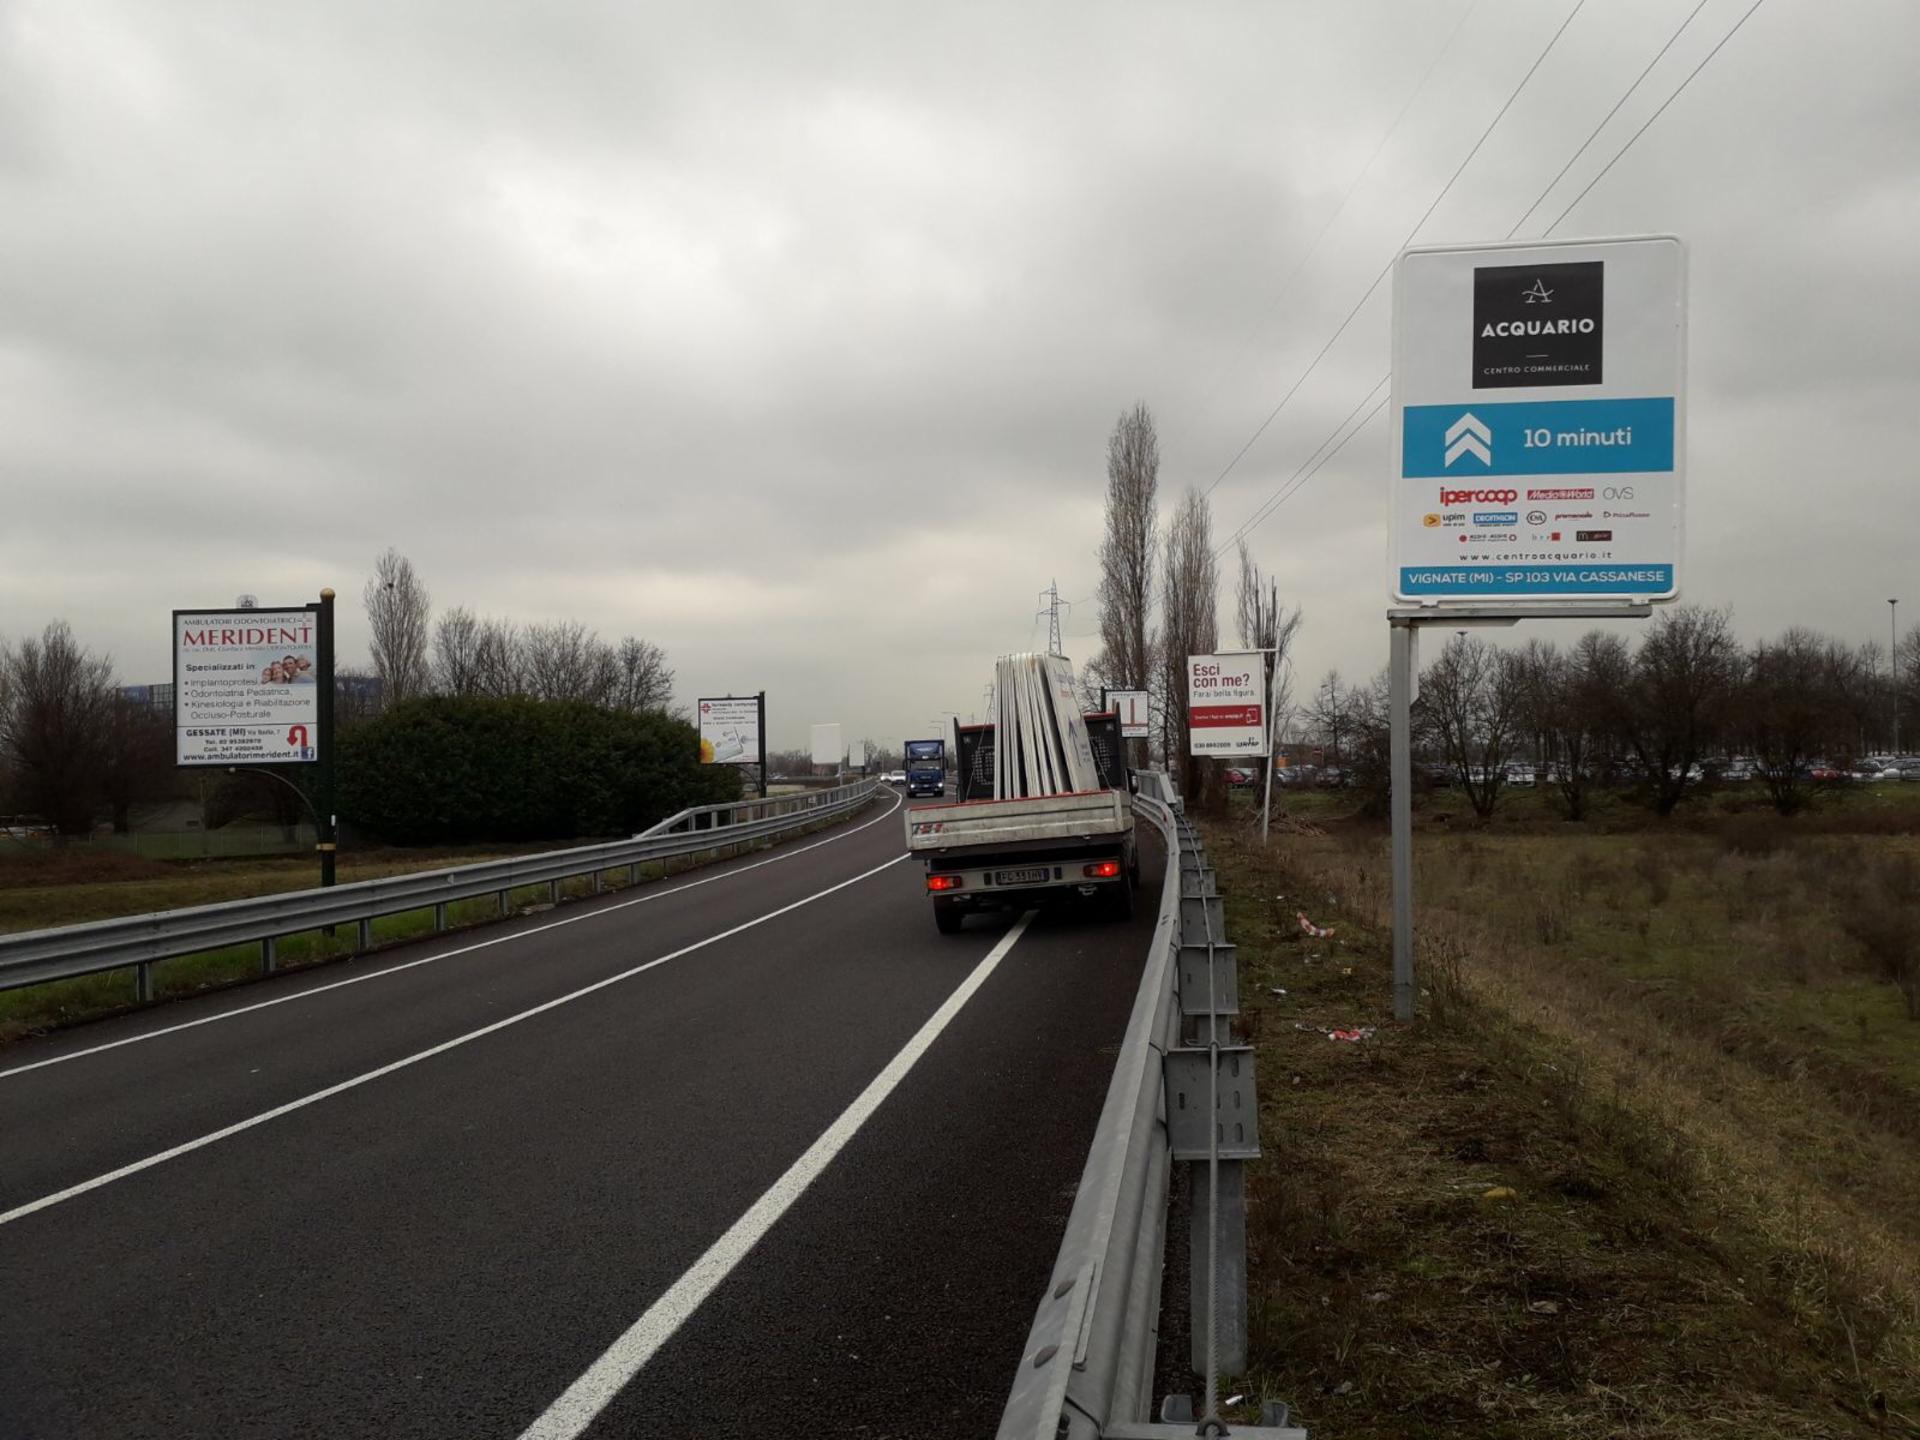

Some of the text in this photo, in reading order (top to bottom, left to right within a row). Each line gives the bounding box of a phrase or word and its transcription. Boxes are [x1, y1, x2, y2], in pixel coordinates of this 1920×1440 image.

[1481, 318, 1594, 338] ACQUARIO
[1484, 363, 1590, 375] CENTRO COMMERCIALE
[1523, 426, 1632, 448] 10 minuti
[1439, 487, 1518, 506] ipercoop
[1602, 486, 1634, 500] OVS
[1442, 512, 1466, 523] upim
[1459, 552, 1612, 561] www.centroacquario.it
[1408, 573, 1467, 584] VIGNATE
[1469, 572, 1495, 585] (MI)
[1505, 571, 1524, 583] SP
[1526, 571, 1550, 583] 103
[1552, 571, 1577, 583] VIA
[1578, 569, 1665, 583] CASSANESE
[184, 628, 312, 645] MERIDENT
[186, 664, 244, 673] Specializzati
[1193, 663, 1220, 676] Esci
[1193, 673, 1250, 688] con me?
[191, 688, 245, 698] Odontoiatria
[191, 700, 243, 711] Kinesiologia
[191, 710, 272, 720] Occluso-Posturale
[186, 728, 227, 737] GESSATE
